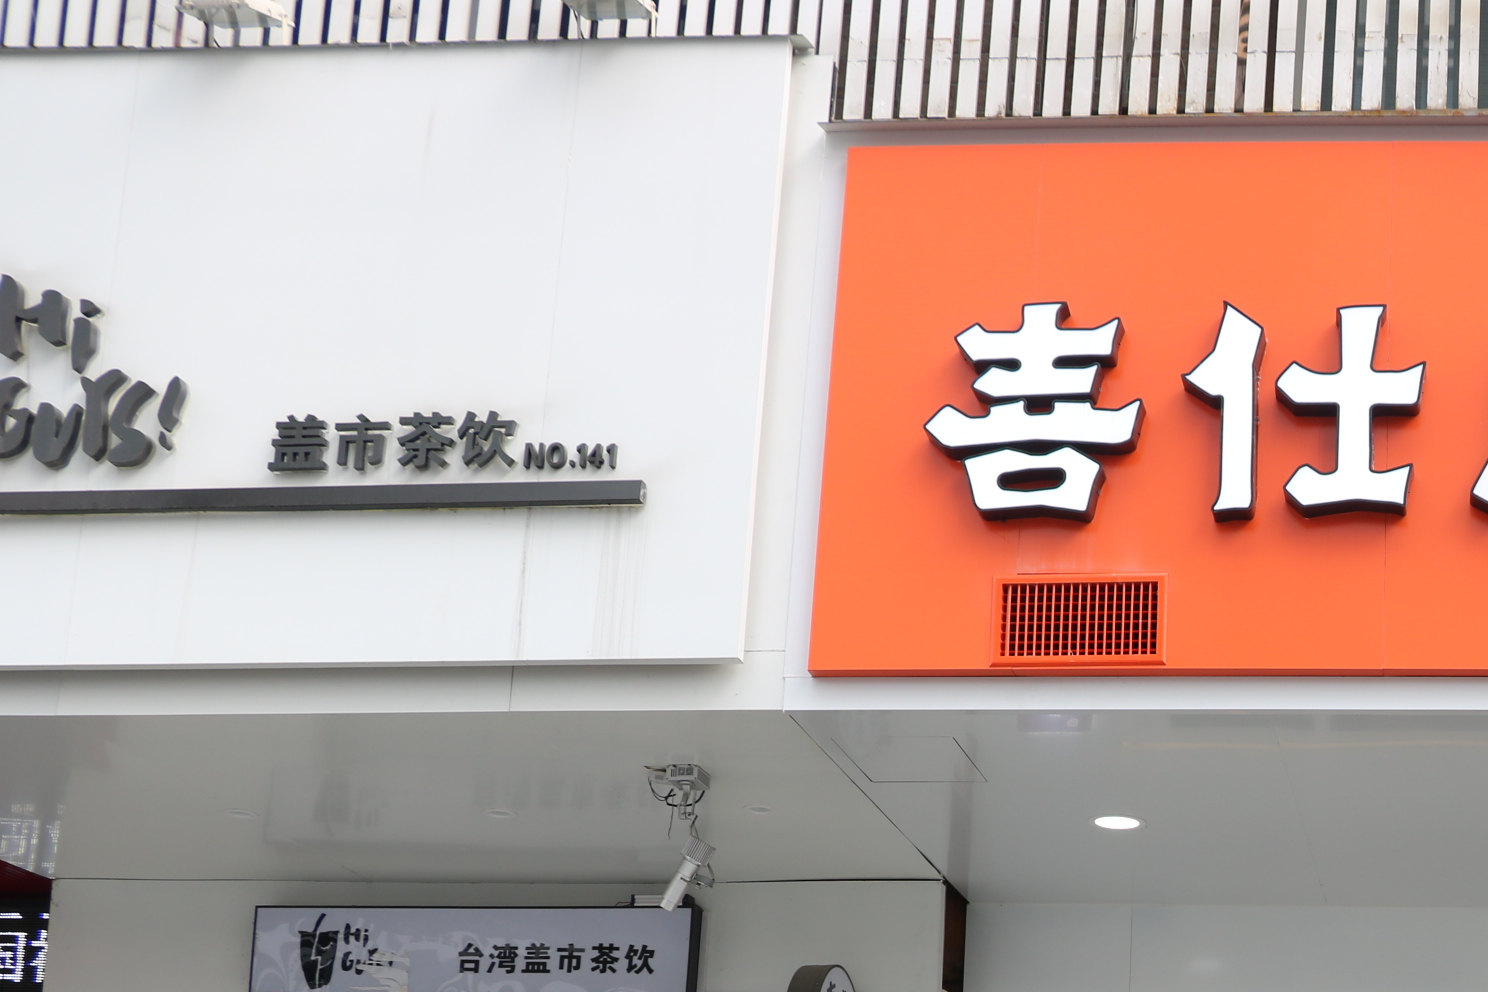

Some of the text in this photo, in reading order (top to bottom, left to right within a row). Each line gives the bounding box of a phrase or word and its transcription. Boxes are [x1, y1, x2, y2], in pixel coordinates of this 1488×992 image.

[0, 273, 104, 374] Hi
[267, 410, 519, 474] 盖市茶饮
[523, 442, 618, 469] NO.141
[343, 923, 369, 947] Hi
[458, 943, 656, 975] 台湾盖市茶饮
